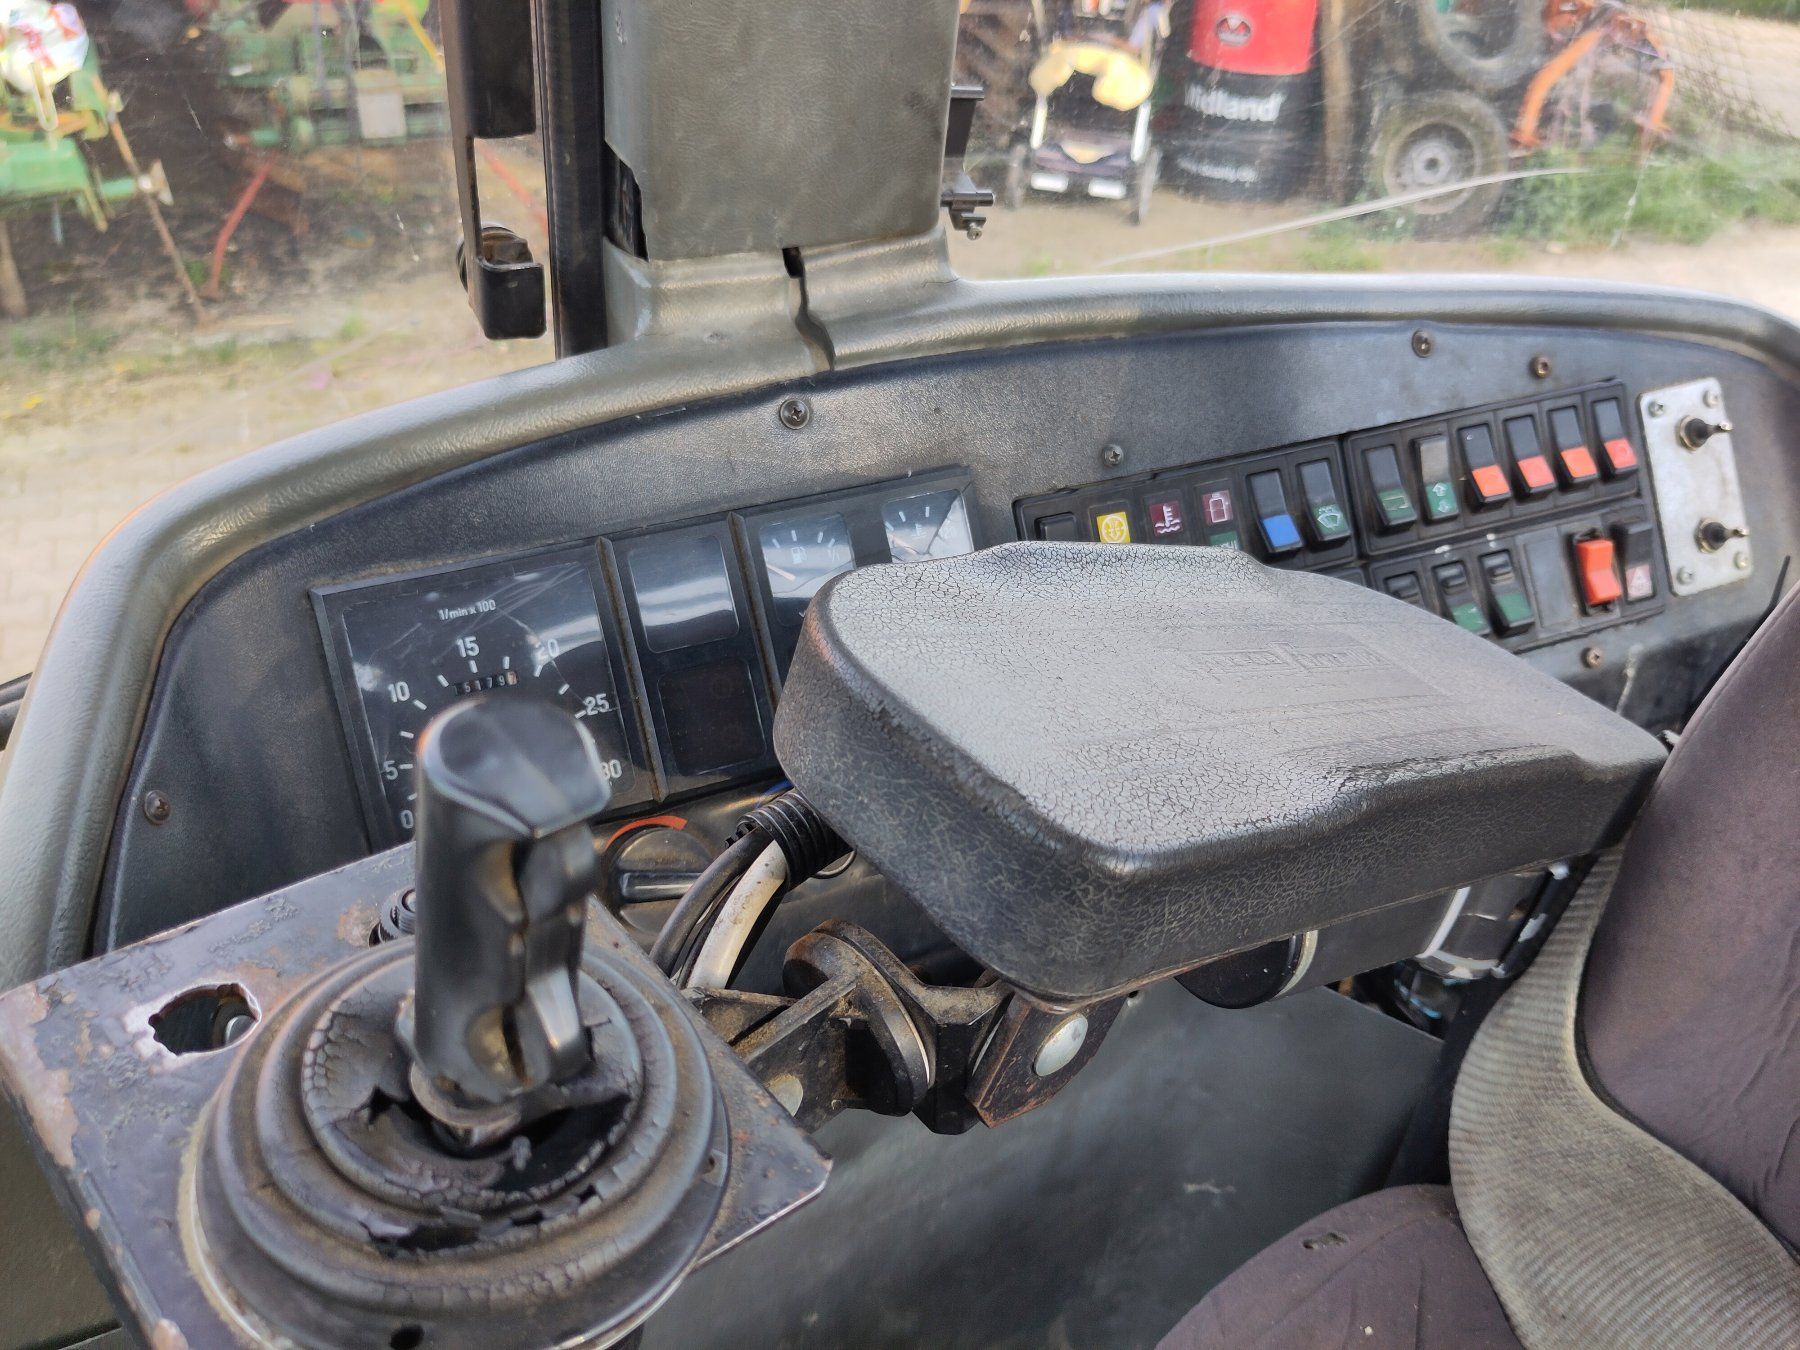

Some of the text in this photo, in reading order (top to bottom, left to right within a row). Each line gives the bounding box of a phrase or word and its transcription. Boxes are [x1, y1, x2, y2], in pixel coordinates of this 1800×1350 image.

[438, 607, 468, 620] 1/min
[477, 599, 496, 612] 100
[456, 636, 480, 658] 15
[535, 638, 560, 663] 20
[388, 681, 410, 702] 10
[582, 693, 610, 715] 25
[383, 760, 398, 780] 5
[401, 809, 413, 829] 0
